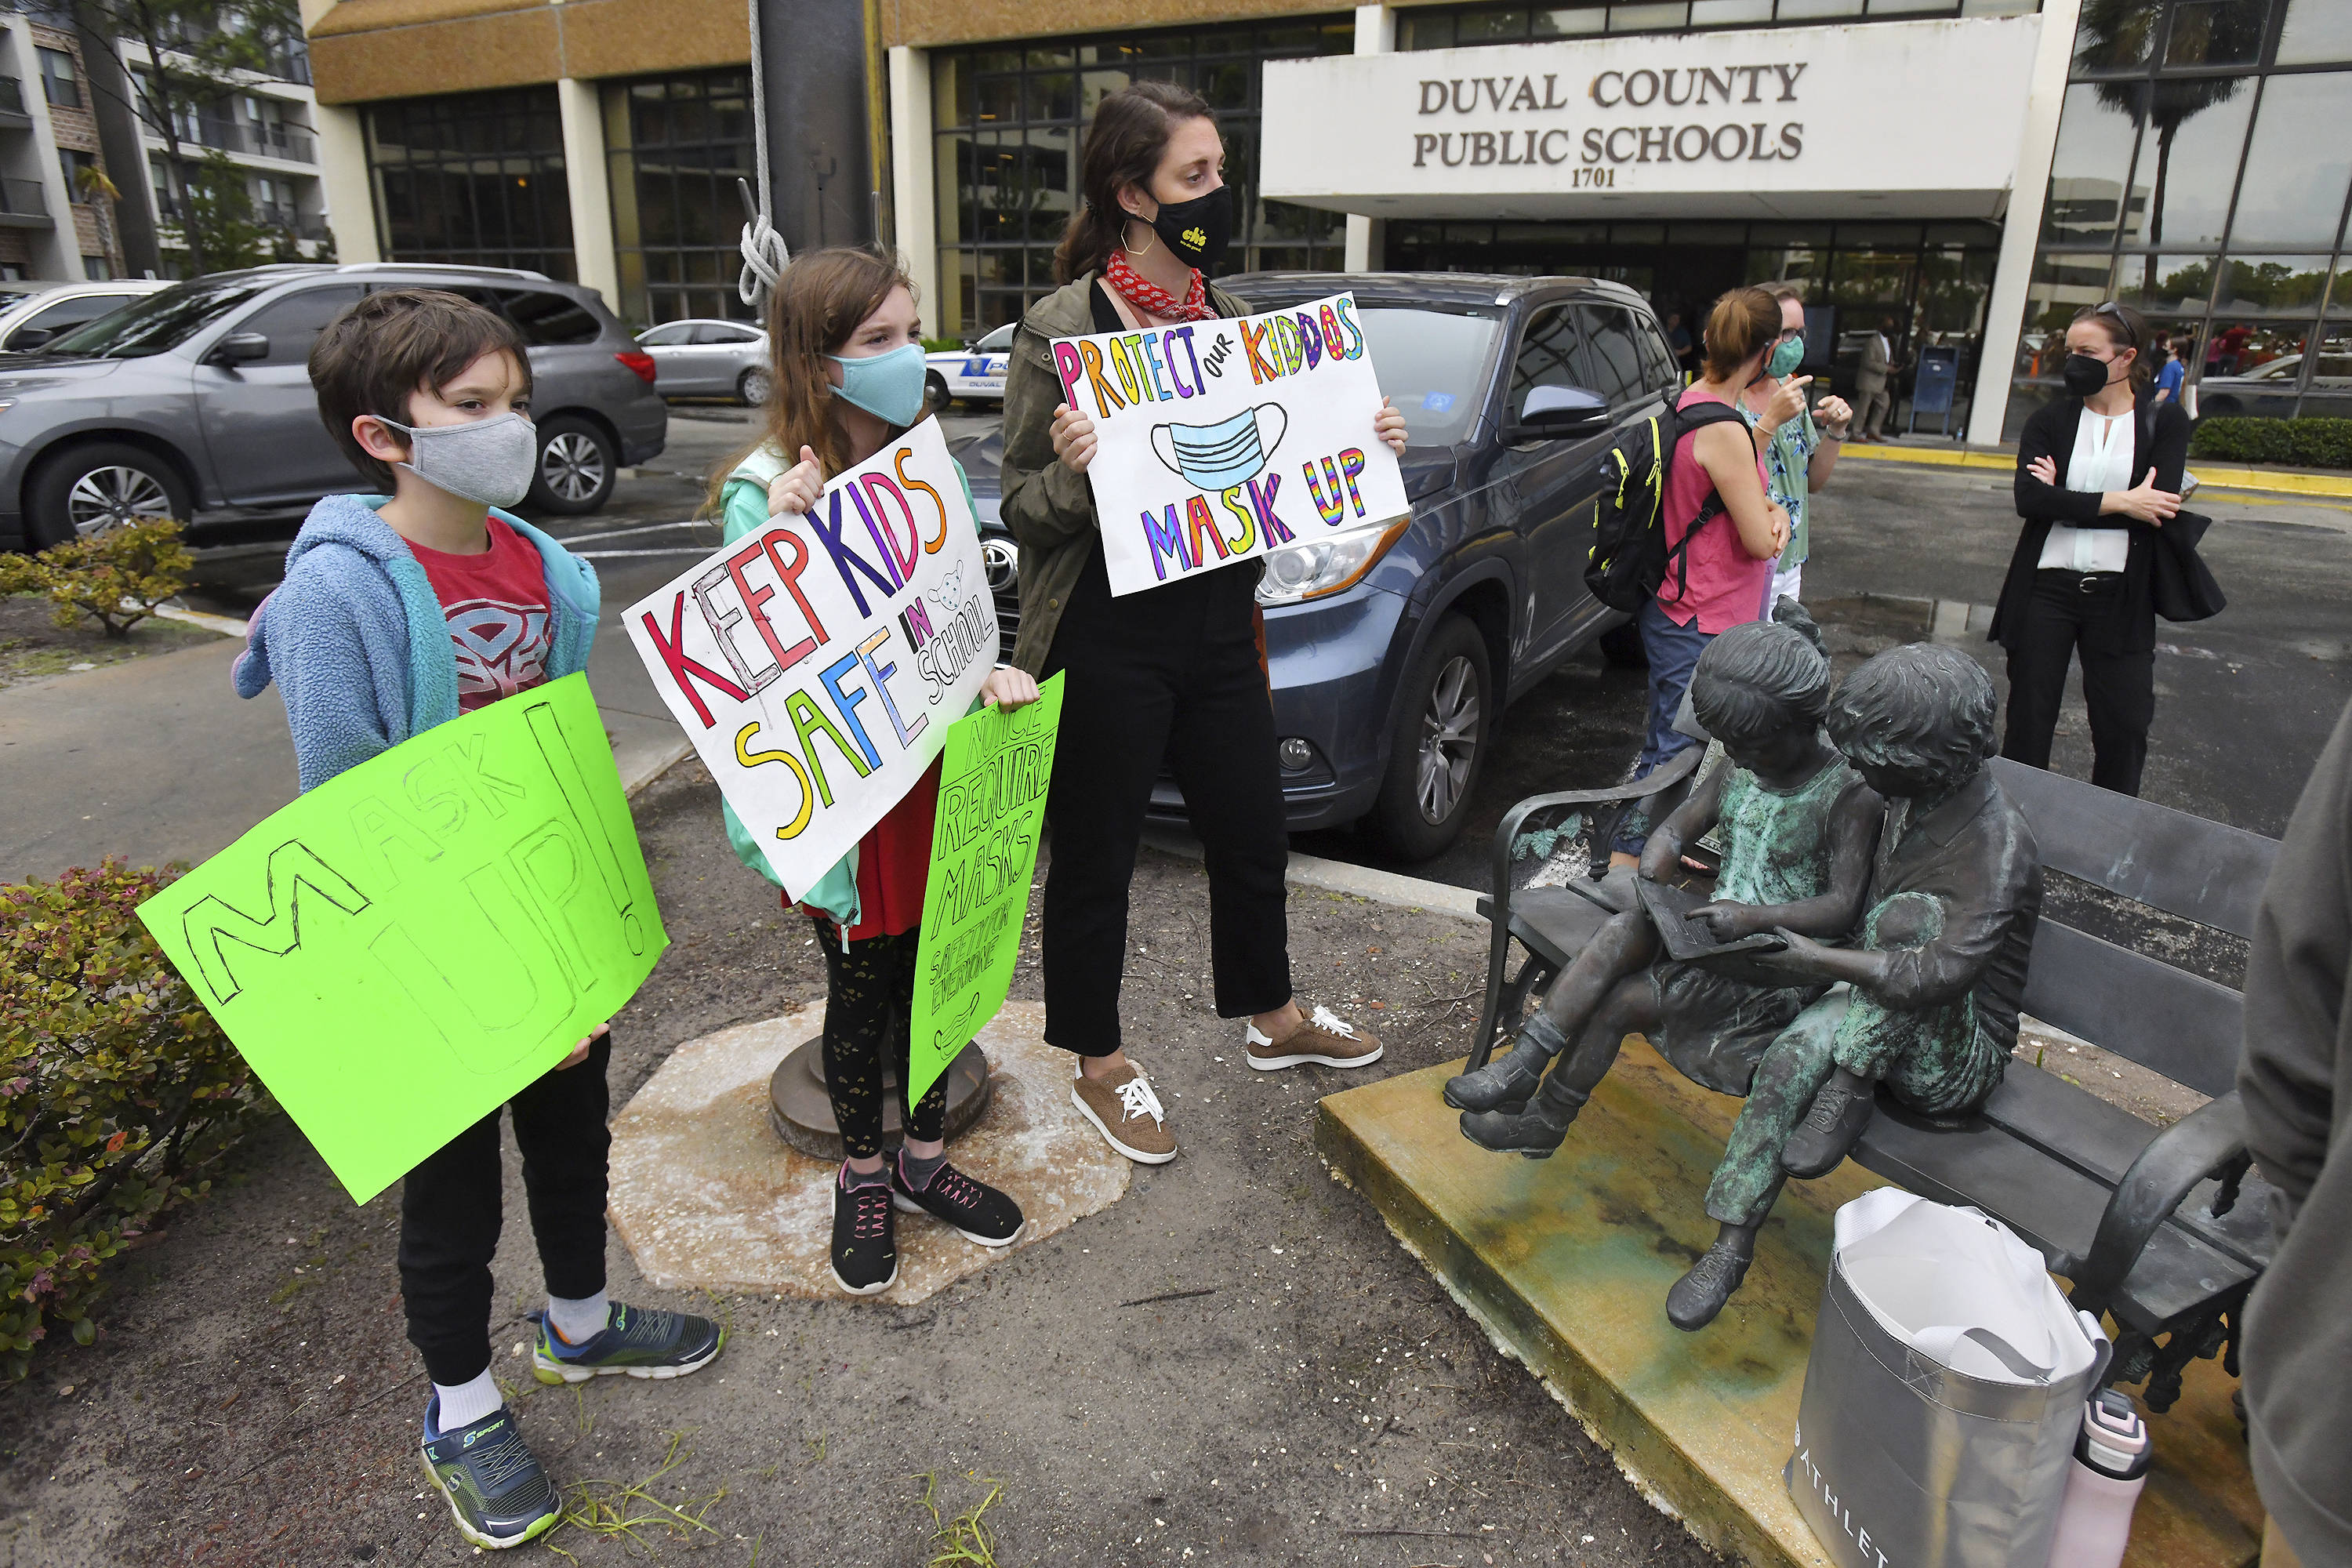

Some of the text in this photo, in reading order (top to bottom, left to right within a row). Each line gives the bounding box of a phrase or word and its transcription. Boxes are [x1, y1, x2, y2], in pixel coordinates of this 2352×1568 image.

[1412, 122, 1804, 167] PUBLIC SCHOOLS
[1417, 62, 1808, 114] DUVAL COUNTY
[1572, 167, 1615, 187] 1701
[1053, 298, 1363, 418] PROTECT OUR KIDDOS
[1140, 448, 1365, 580] MASK UP
[641, 447, 947, 729] KEEP KIDS
[916, 593, 993, 705] SCHOOL
[734, 596, 935, 840] SAFE IN
[938, 732, 1054, 862] REQUIRE
[183, 732, 526, 1007] MASK
[931, 810, 1033, 942] MASKS
[476, 1418, 506, 1439] SPORT
